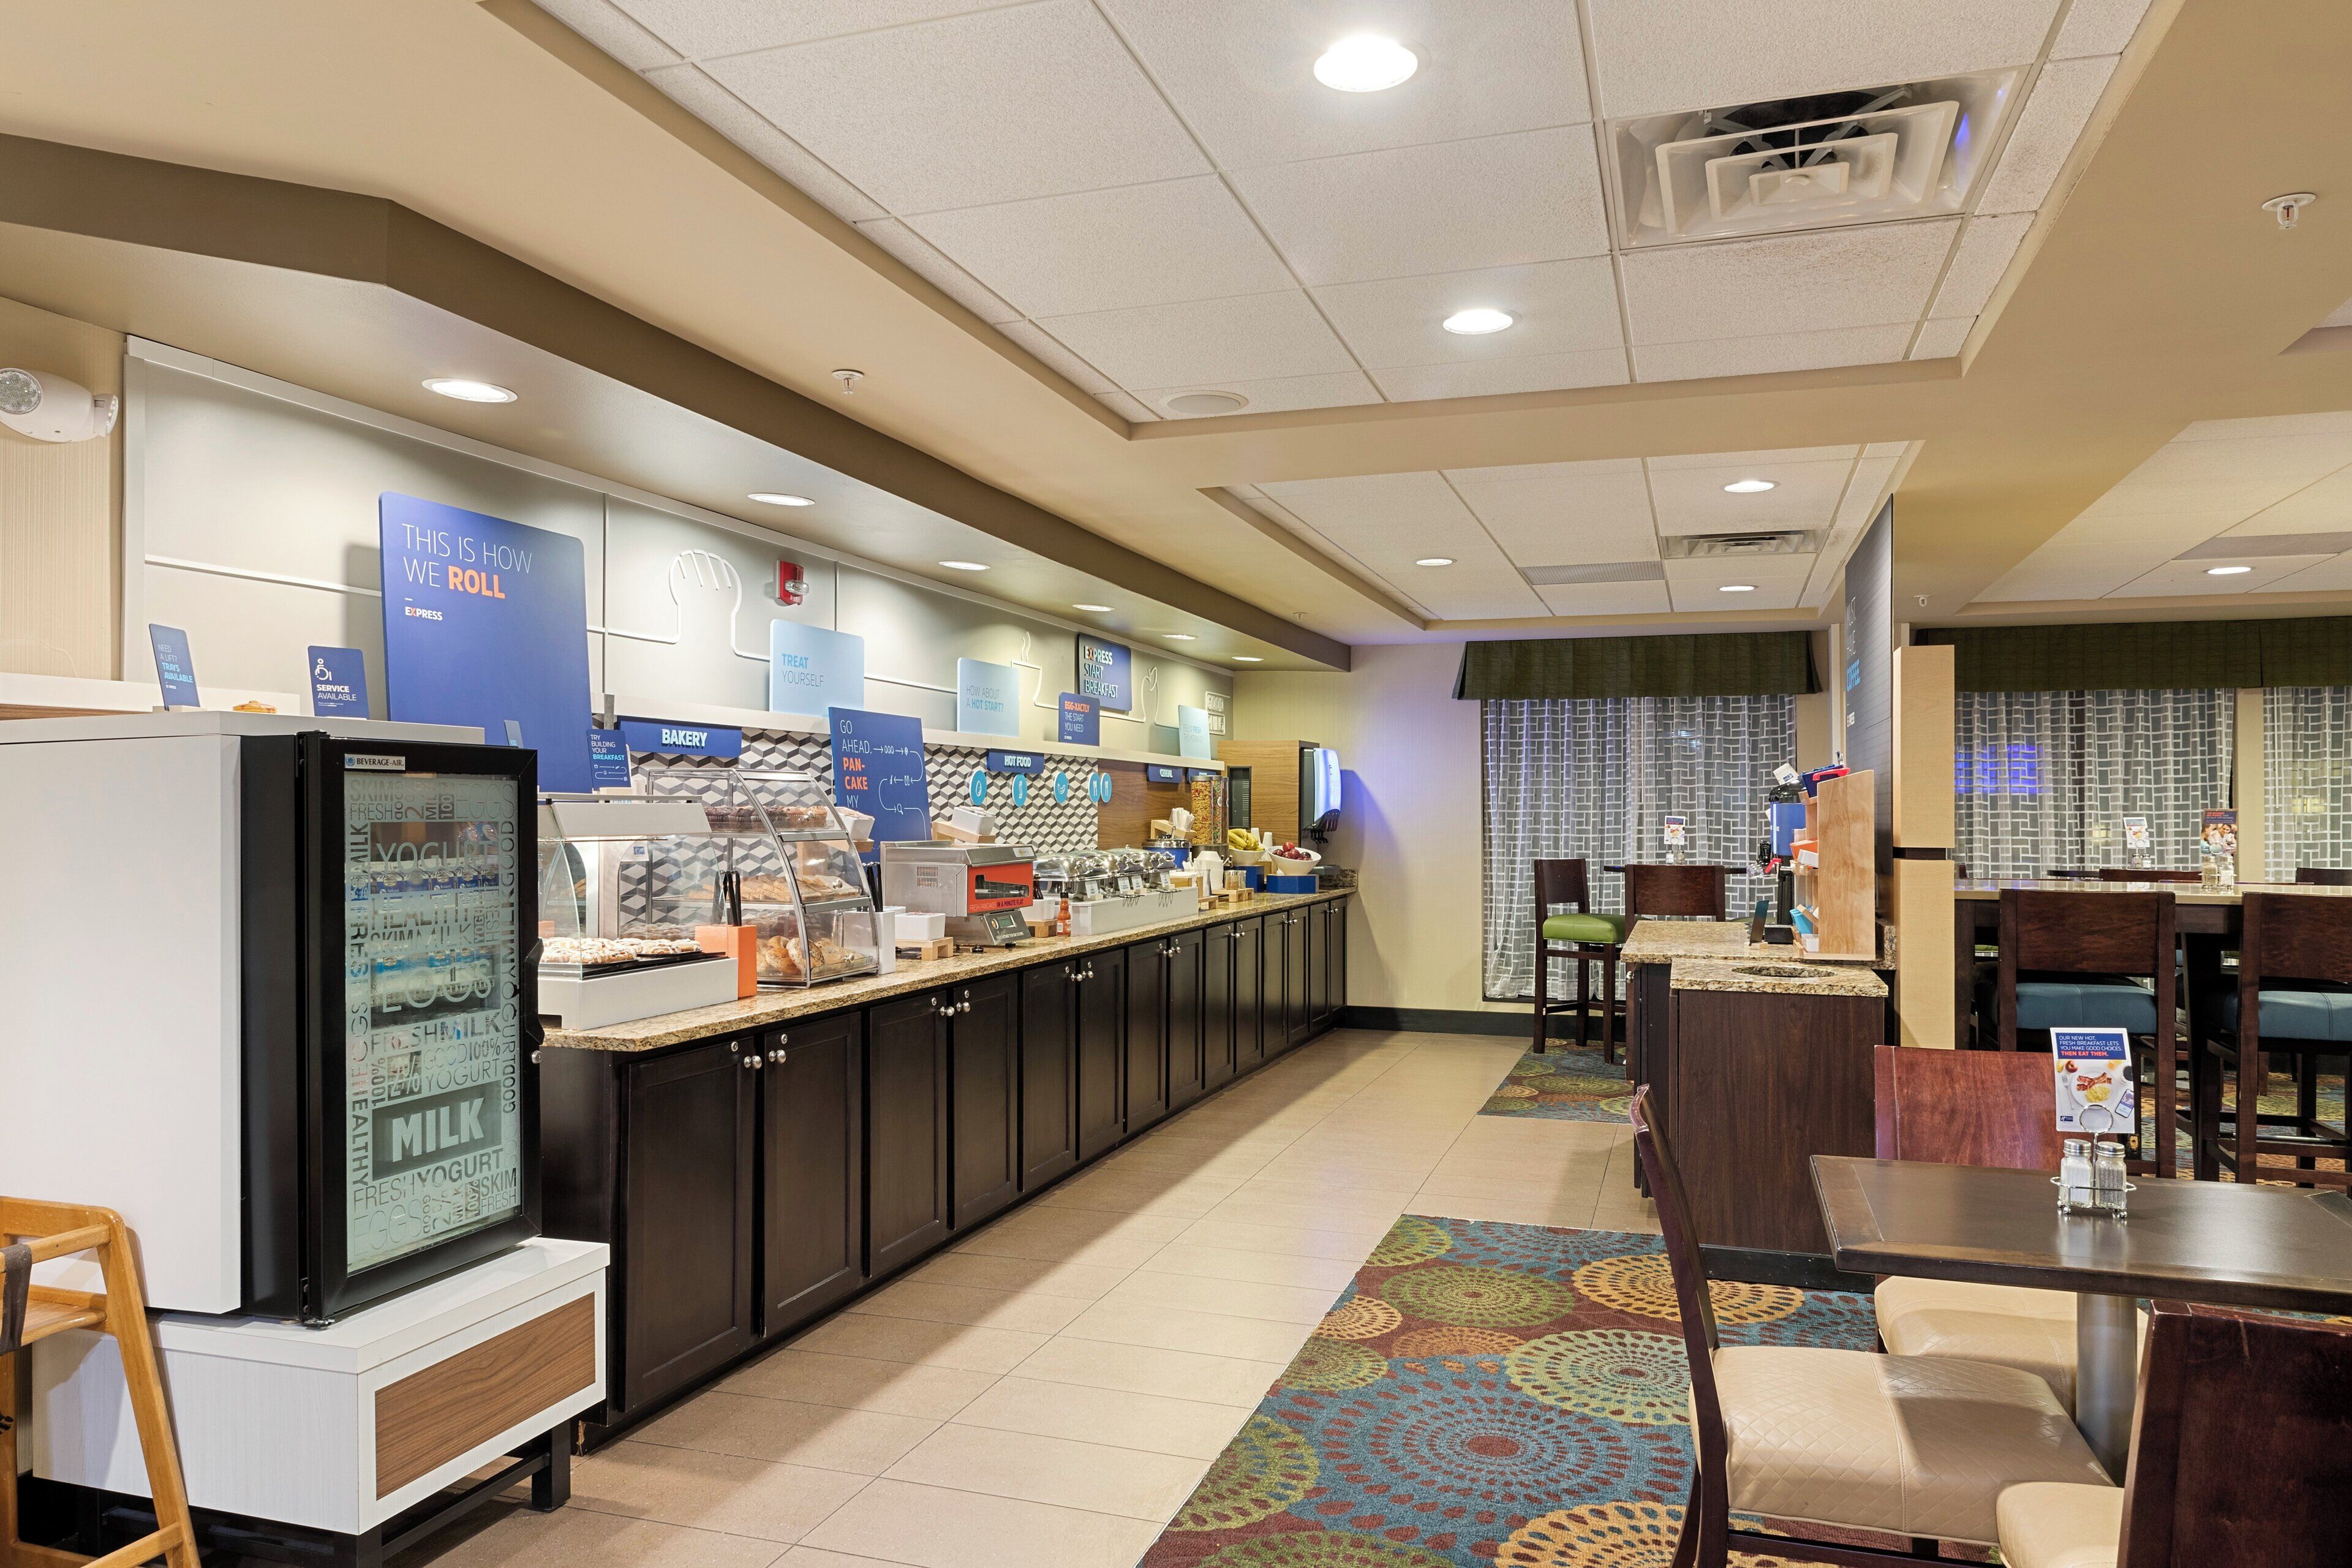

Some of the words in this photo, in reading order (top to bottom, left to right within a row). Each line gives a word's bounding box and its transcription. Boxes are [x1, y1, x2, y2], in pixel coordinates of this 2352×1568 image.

[402, 523, 450, 557] THIS
[459, 536, 475, 562] IS
[483, 542, 532, 573] HOW
[404, 556, 440, 587] WE
[448, 565, 505, 598] ROLL
[405, 606, 443, 620] EXPRESS
[158, 644, 172, 653] NEED
[1084, 646, 1113, 665] EXPRESS
[162, 662, 180, 672] TRAYS
[165, 654, 178, 663] LIFT?
[782, 653, 809, 669] TREAT
[164, 672, 194, 683] AVAILABLE
[782, 669, 824, 688] YOURSELF
[1084, 662, 1104, 679] START
[1847, 659, 1861, 692] COFFEE
[317, 684, 350, 693] SERVICE
[317, 692, 357, 701] AVAILABLE
[967, 685, 981, 696] HOW
[982, 687, 1000, 699] ABOUT
[1085, 679, 1118, 698] BREAKFAST
[967, 698, 970, 708] A
[971, 699, 983, 709] HOT
[985, 701, 1004, 712] START?
[1065, 701, 1090, 713] EGG-XACTLY
[1207, 695, 1224, 712] GOOD
[1072, 713, 1084, 722] START
[840, 720, 852, 734] GO
[1074, 723, 1084, 733] NEED
[662, 729, 707, 747] BAKERY
[842, 739, 872, 754] AHEAD.
[843, 757, 865, 771] PAN-
[1005, 755, 1016, 766] HOT
[1017, 756, 1031, 767] FOOD
[845, 776, 868, 790] CAKE
[846, 795, 859, 808] MY
[350, 803, 393, 820] FRESH
[376, 841, 494, 875] YOGURT
[500, 821, 514, 887] GOOD
[502, 965, 517, 1065] YOGURT
[371, 1023, 437, 1055] FRESH
[440, 1012, 501, 1040] MILK
[426, 1058, 500, 1092] YOGURT
[502, 1065, 516, 1114] GOOD
[392, 1097, 484, 1163] MILK
[353, 1174, 415, 1213] FRESH
[417, 1148, 503, 1189] YOGURT
[481, 1167, 516, 1197] SKIM
[467, 1180, 479, 1218] 100%
[481, 1188, 516, 1215] FRESH
[354, 1199, 423, 1257] EGGS
